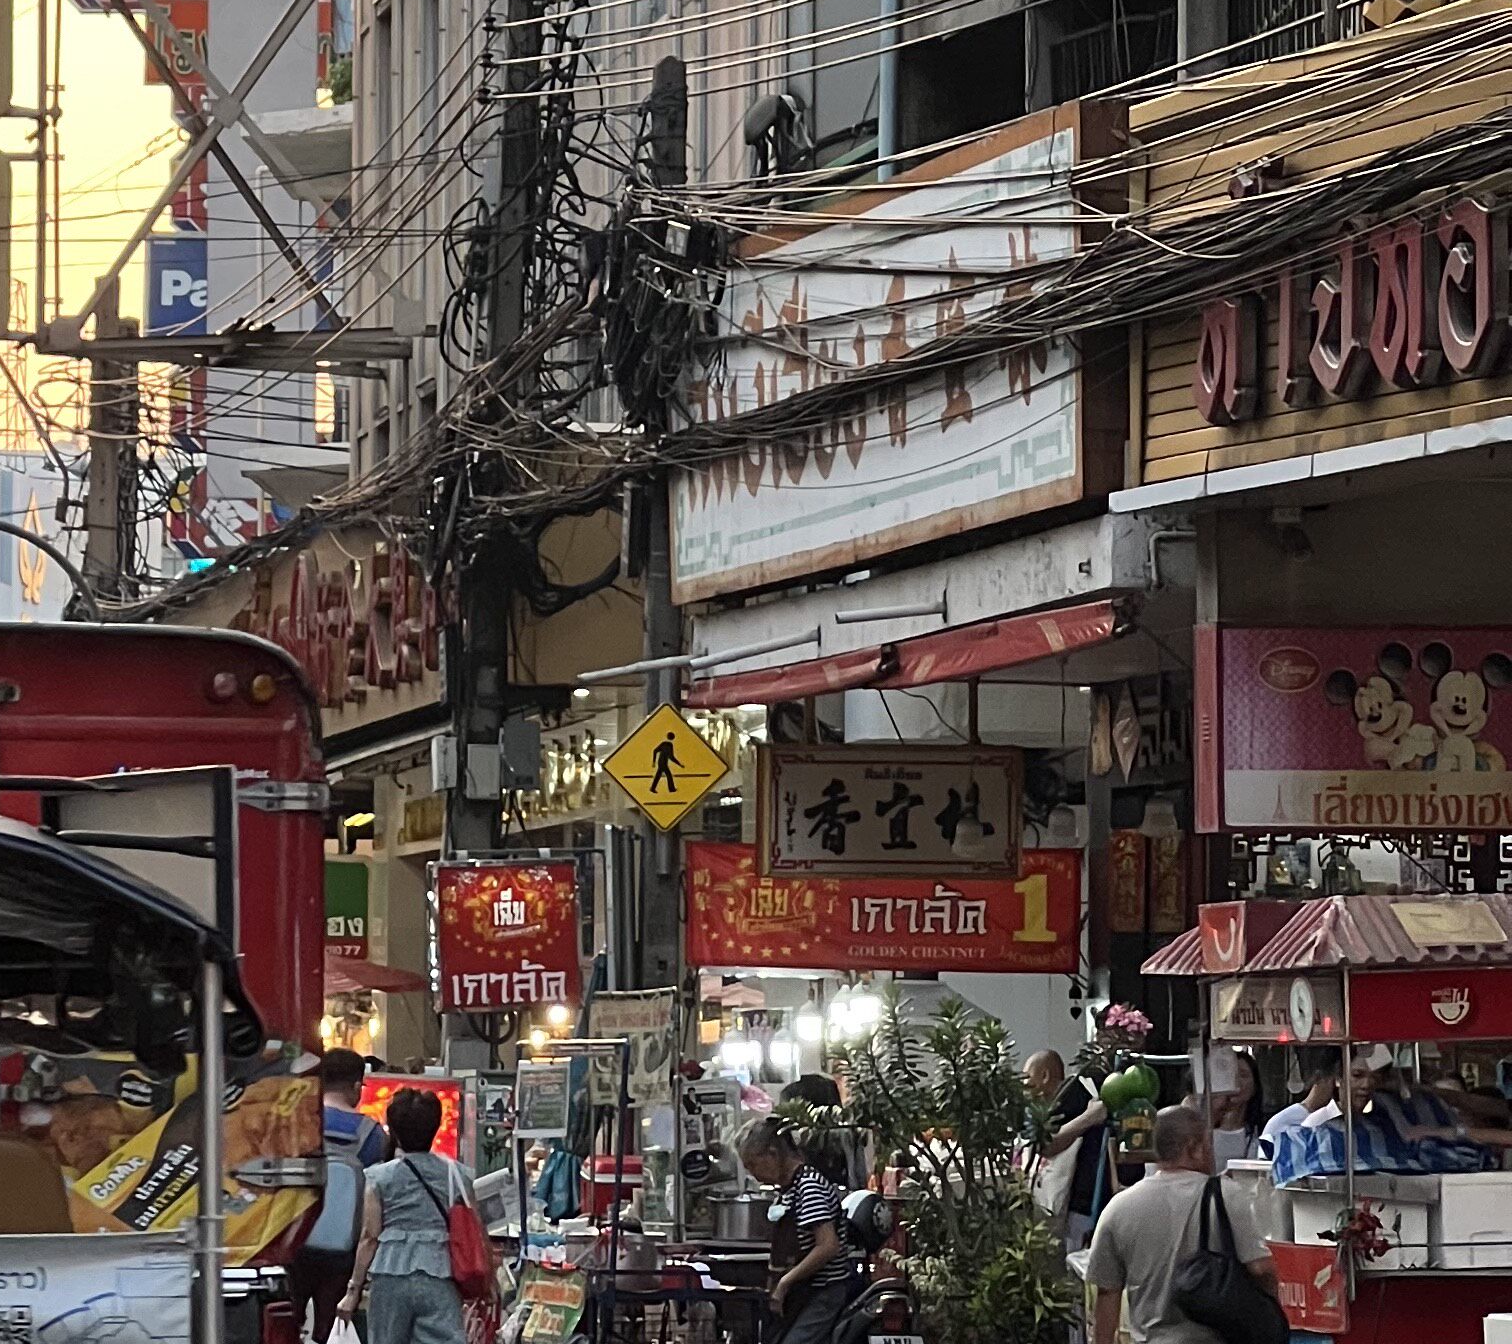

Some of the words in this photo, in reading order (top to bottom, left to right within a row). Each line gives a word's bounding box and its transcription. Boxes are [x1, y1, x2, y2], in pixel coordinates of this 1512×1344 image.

[160, 268, 208, 308] Pa
[849, 884, 988, 935] เกาลัด
[1012, 873, 1058, 943] 1
[848, 944, 908, 958] GOLDEN
[451, 959, 568, 1007] เกาลัด
